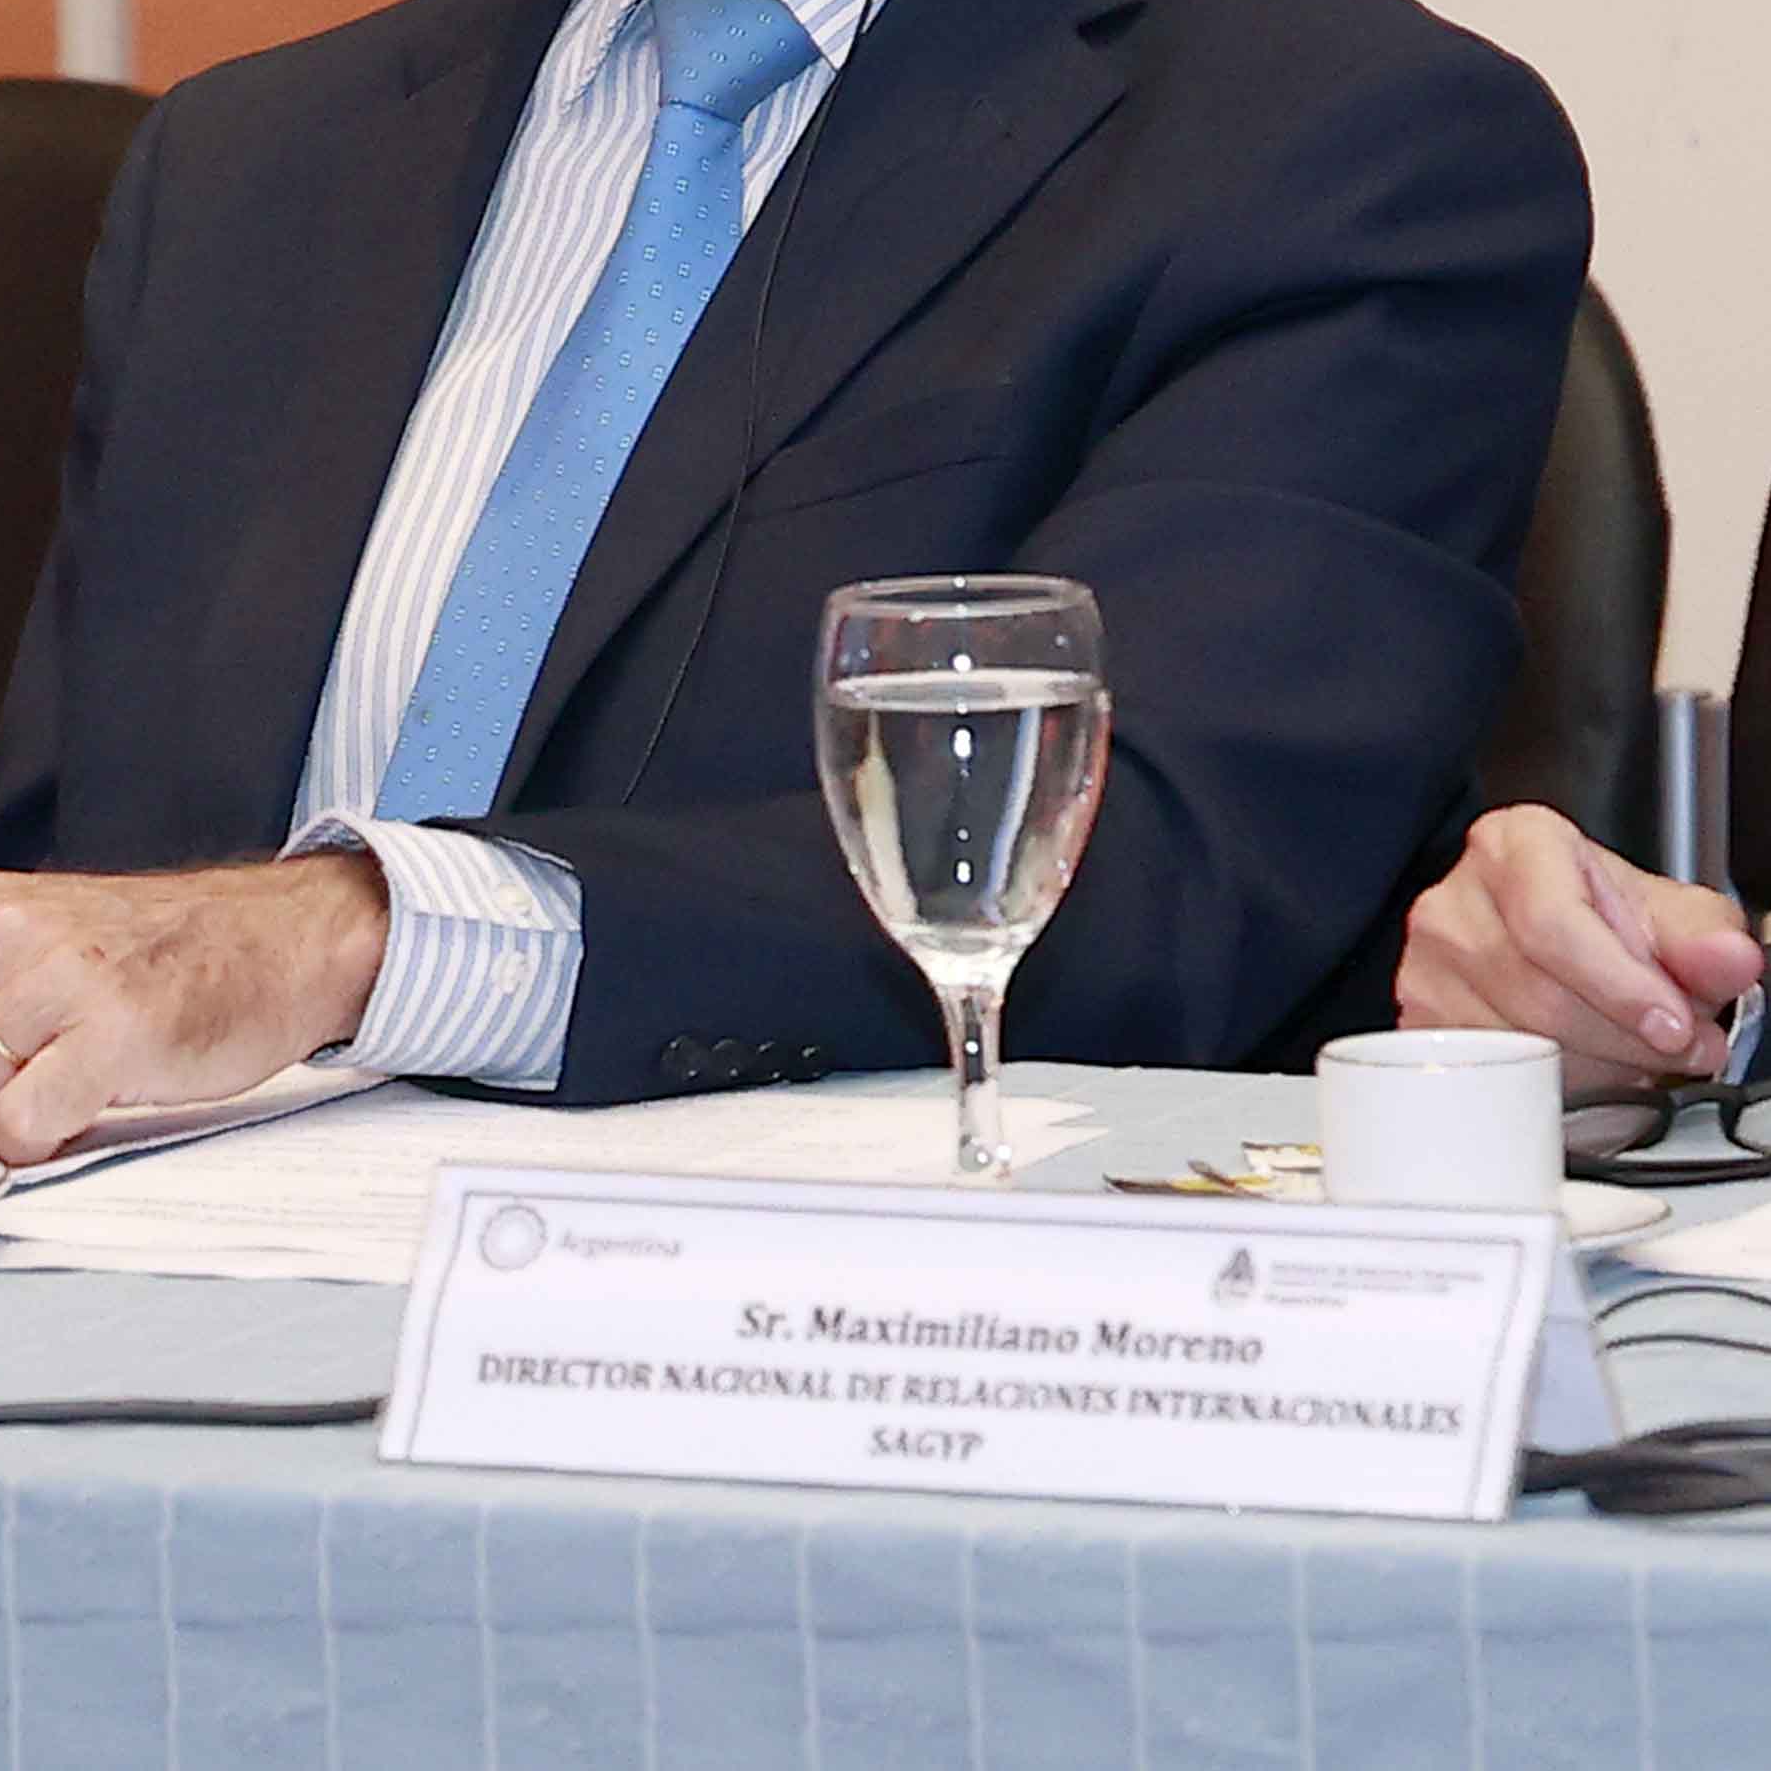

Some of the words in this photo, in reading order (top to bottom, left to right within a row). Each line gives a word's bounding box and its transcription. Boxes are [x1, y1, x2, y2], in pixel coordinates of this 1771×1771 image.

[737, 1303, 793, 1340] Sr.
[806, 1307, 1080, 1355] Maximiliano
[1090, 1319, 1263, 1364] Moreno
[477, 1353, 653, 1391] DIRECTOR
[661, 1363, 836, 1400] NACIONAL
[846, 1372, 894, 1403] DE
[902, 1374, 1118, 1413] RELACIONES
[1127, 1387, 1462, 1435] INTERNACIONALES
